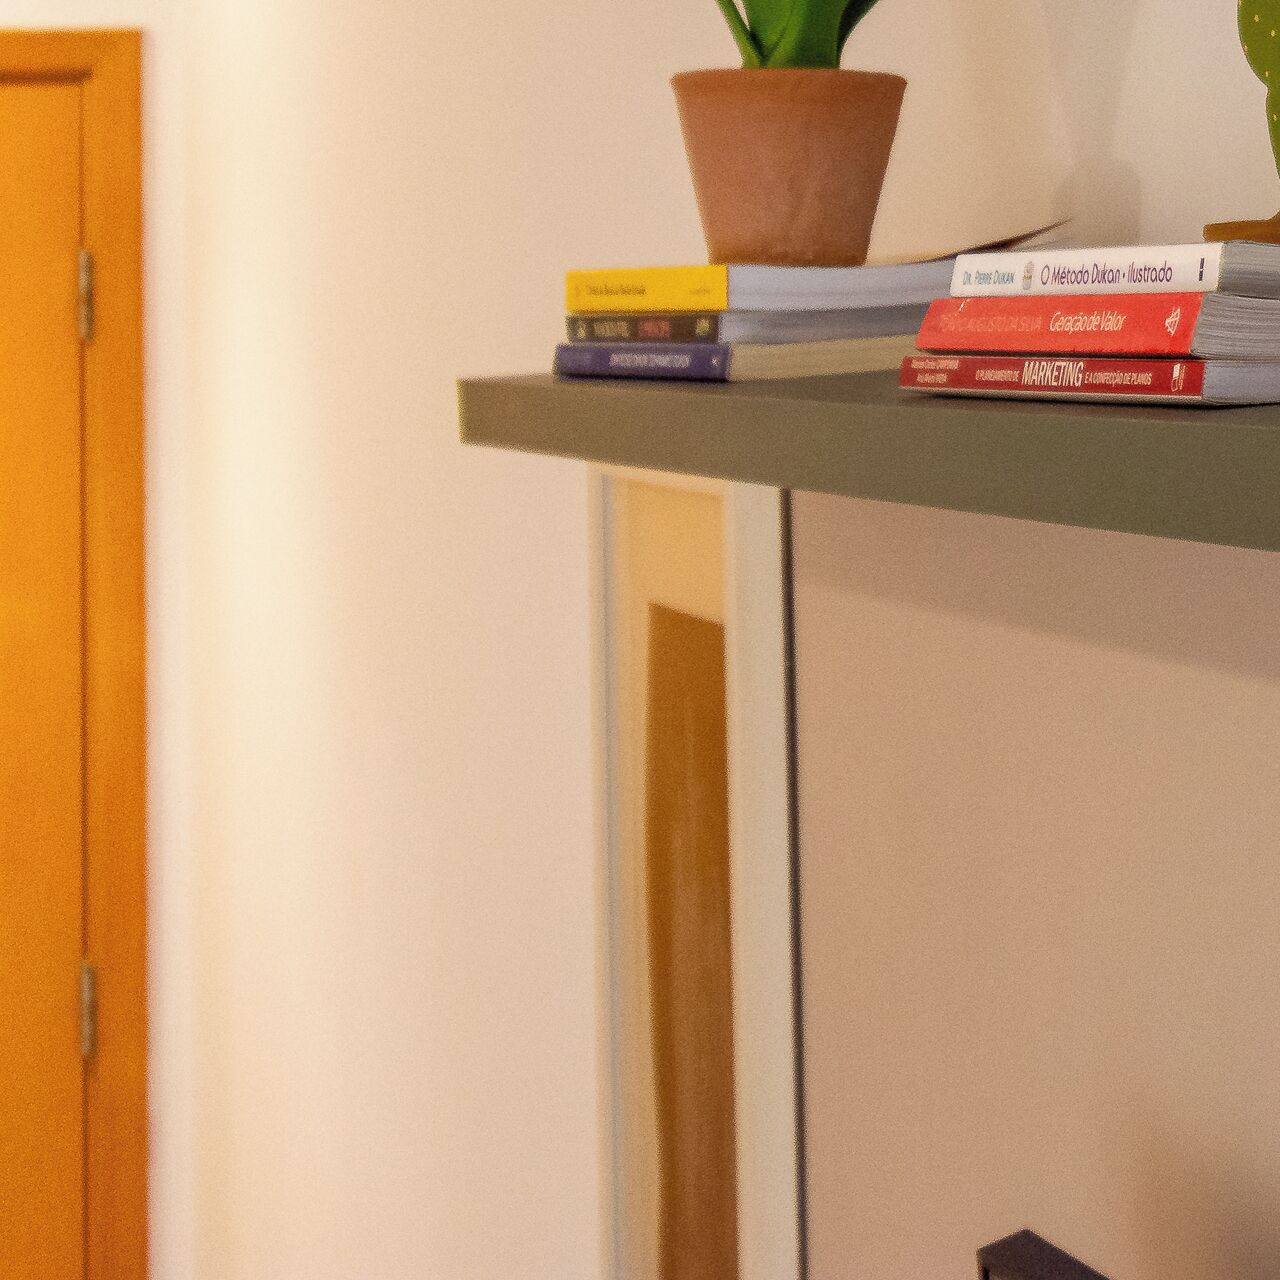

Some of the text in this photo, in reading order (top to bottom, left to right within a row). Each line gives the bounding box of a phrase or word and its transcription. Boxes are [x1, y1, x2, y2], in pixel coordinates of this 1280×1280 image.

[1041, 264, 1050, 285] O
[1051, 263, 1089, 285] Método
[1091, 262, 1121, 285] Dukan
[1127, 260, 1173, 284] ilustrado
[1049, 311, 1088, 335] Geração
[1086, 311, 1100, 331] de
[1100, 310, 1127, 331] Valor
[1021, 360, 1084, 387] MARKETING
[1123, 373, 1131, 384] DE
[1131, 373, 1152, 385] PLANOS
